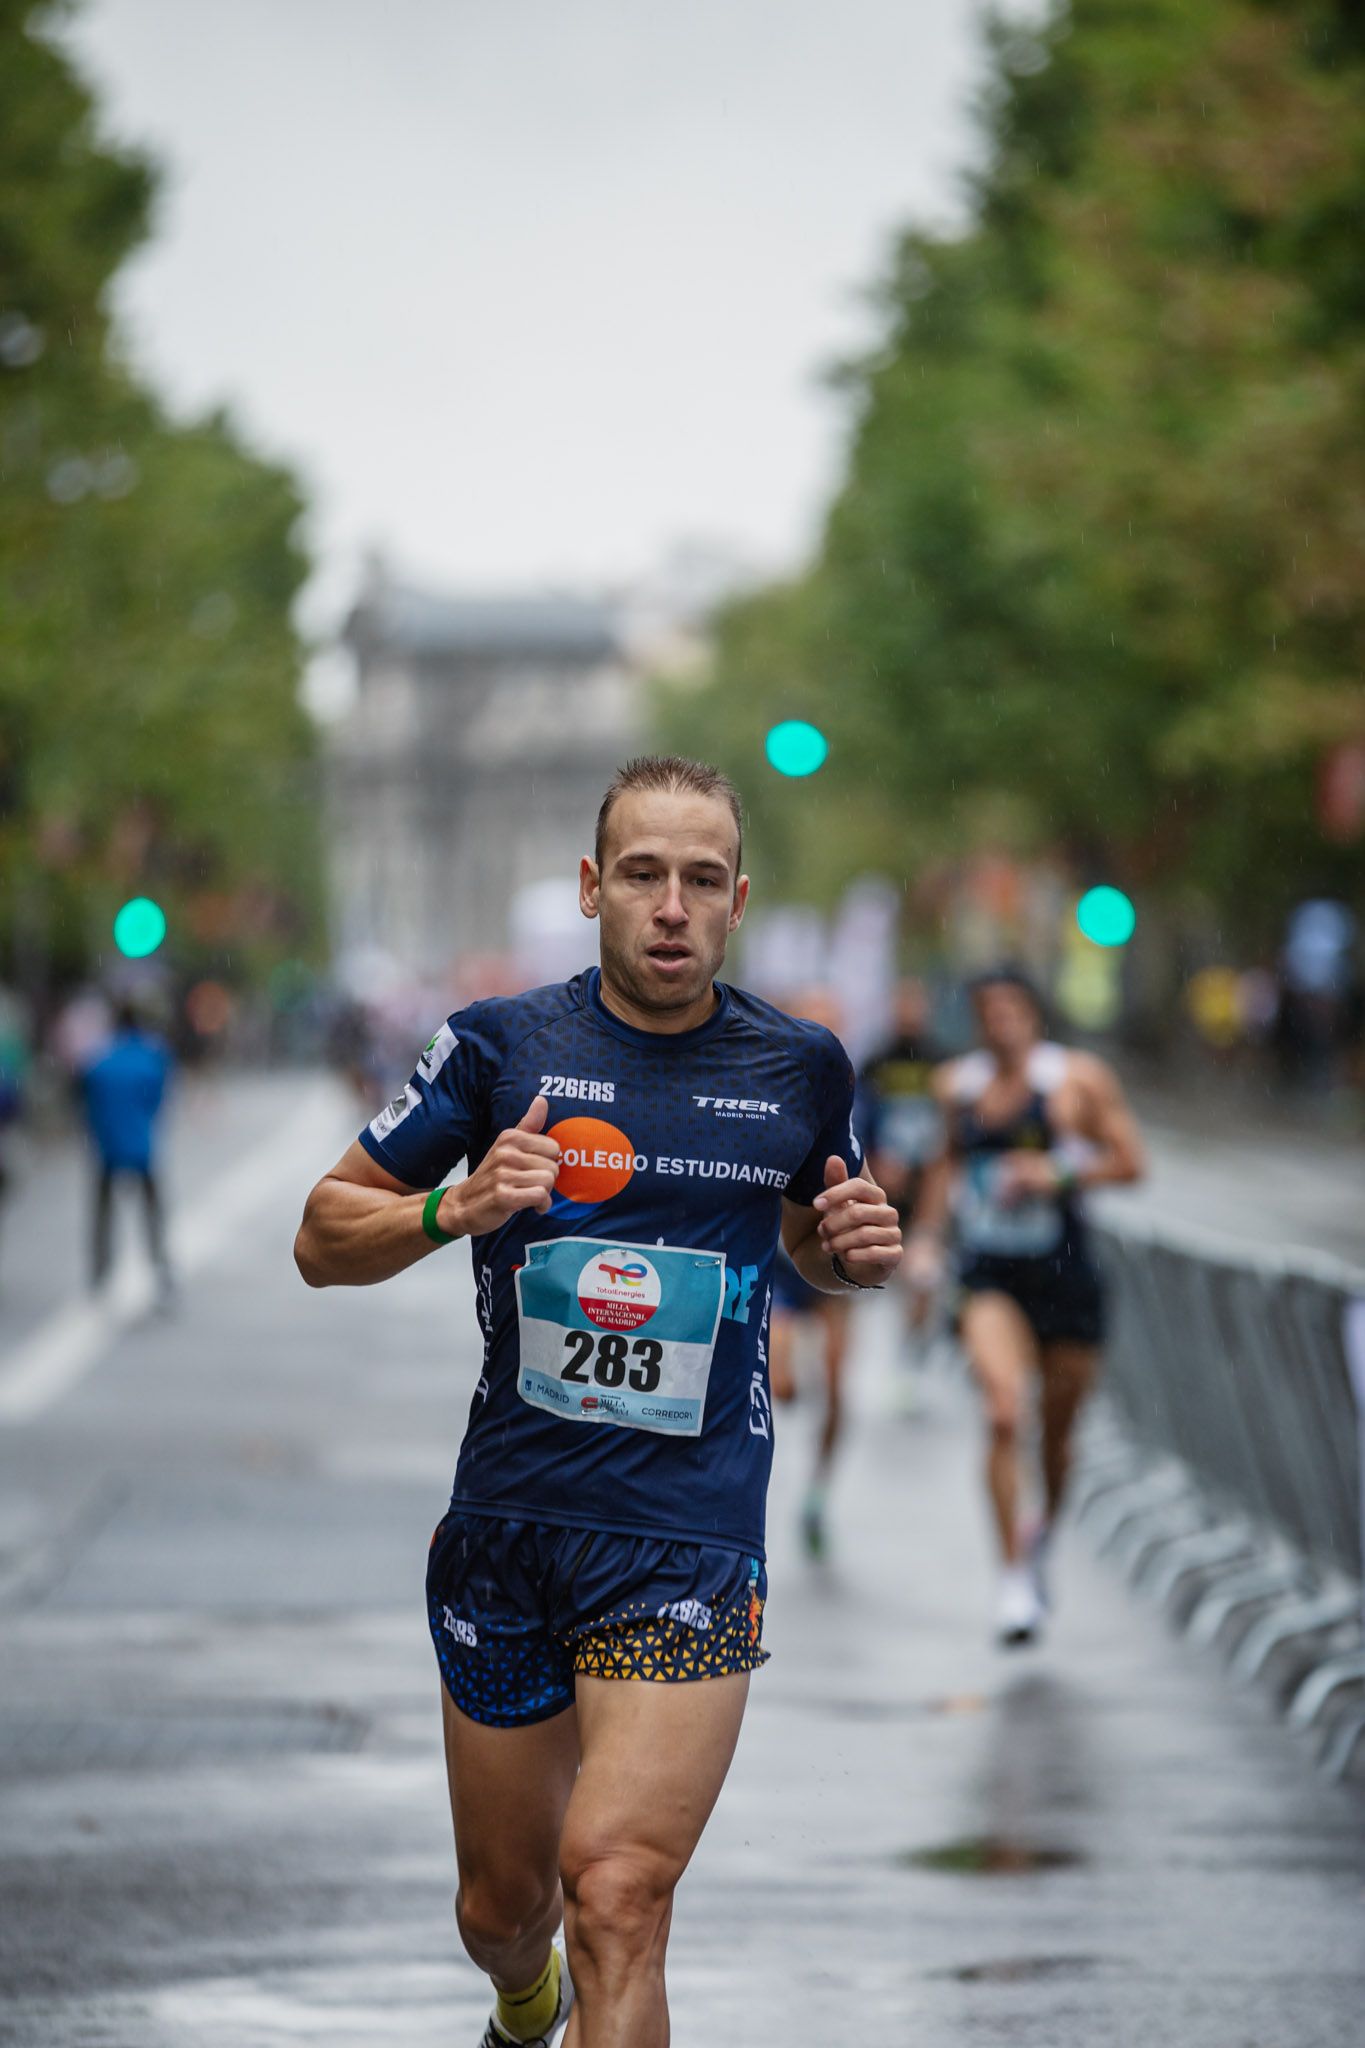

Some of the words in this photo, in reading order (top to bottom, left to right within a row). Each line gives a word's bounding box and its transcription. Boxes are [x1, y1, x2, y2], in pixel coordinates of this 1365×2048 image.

[539, 1075, 616, 1103] 226ERS
[692, 1095, 781, 1115] TREK
[715, 1111, 744, 1119] MADRID
[745, 1113, 766, 1121] NORTE
[656, 1156, 791, 1190] ESTUDIANTES
[597, 1286, 646, 1299] TotalEnergies
[587, 1307, 646, 1321] INTERNACIONAL
[606, 1302, 630, 1312] MILLA
[607, 1317, 637, 1327] MADRID
[561, 1330, 663, 1393] 283
[536, 1384, 570, 1404] MADRID
